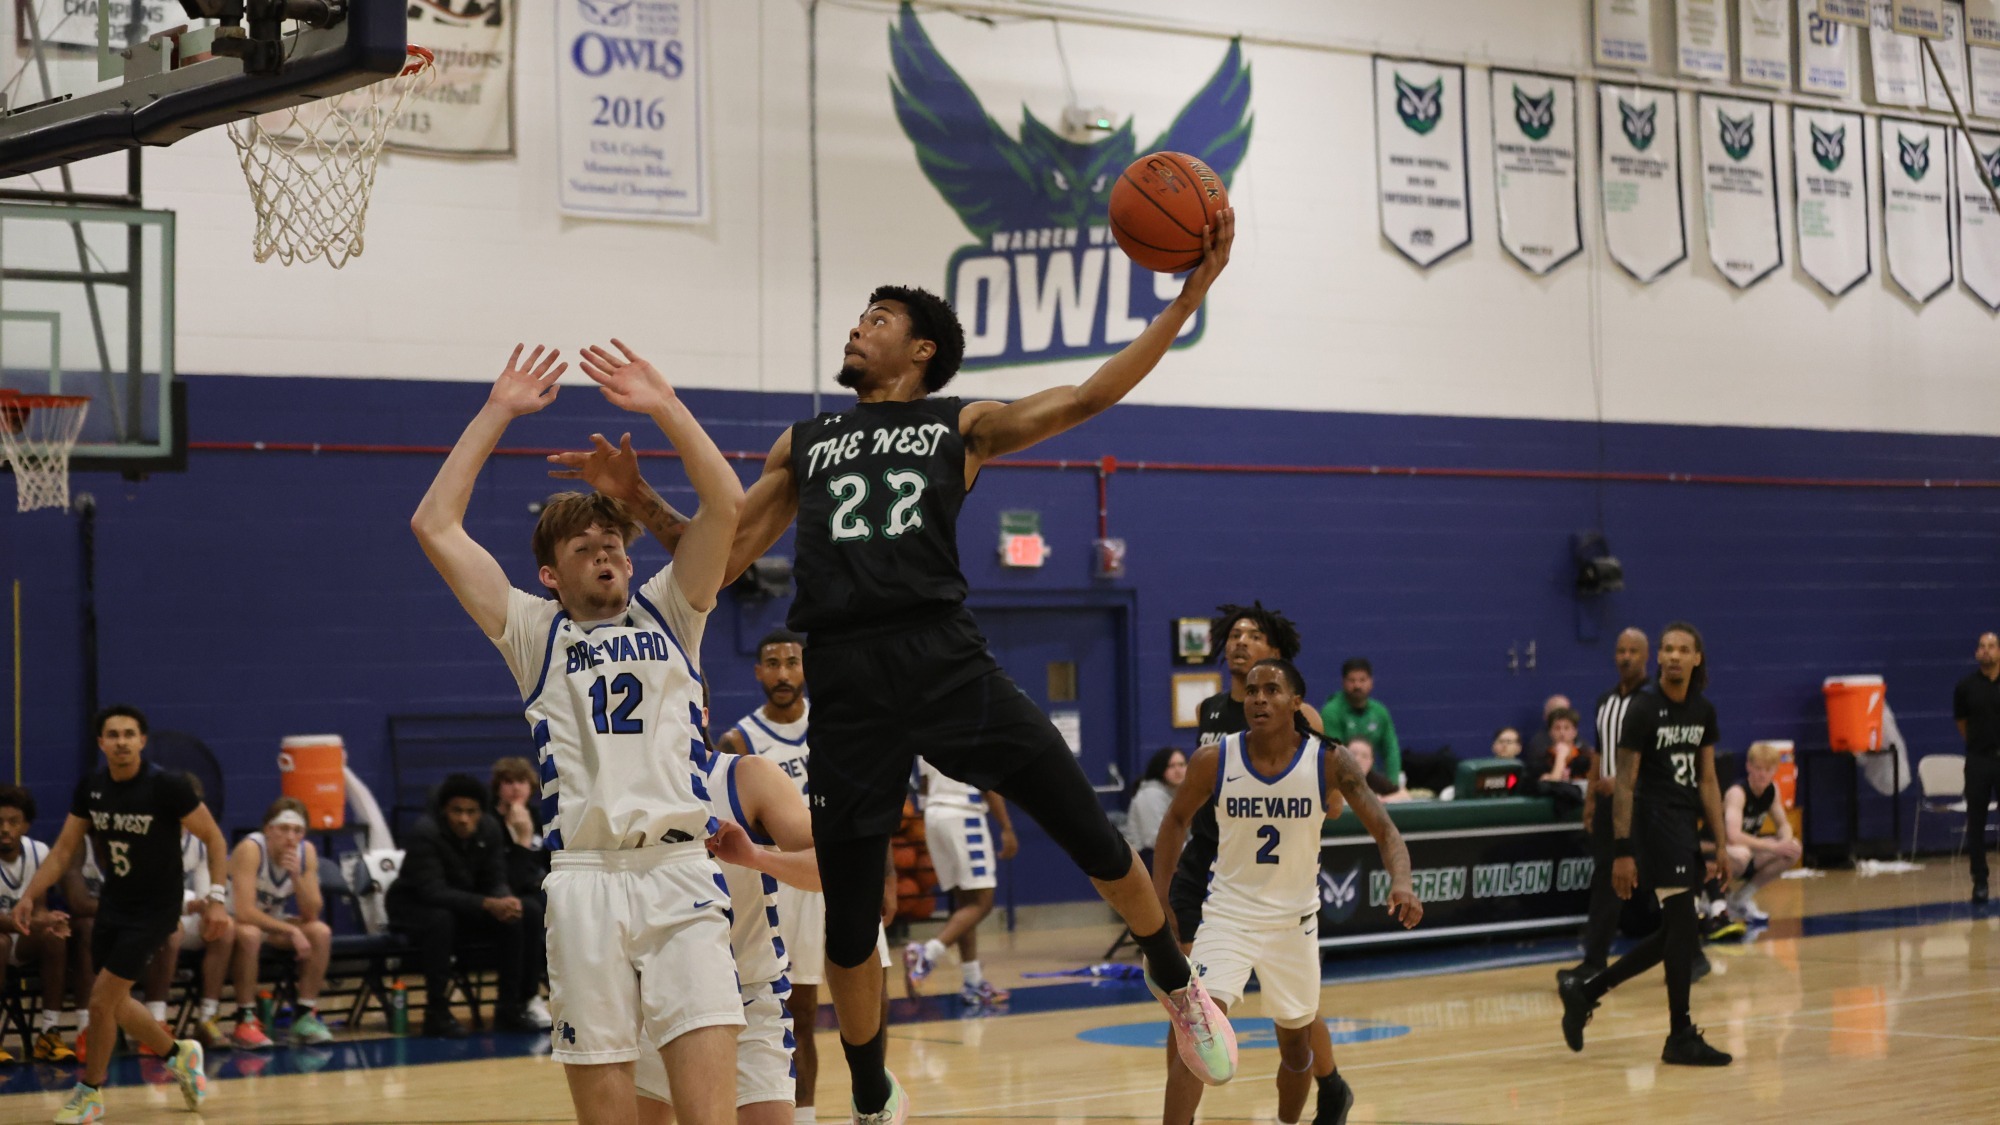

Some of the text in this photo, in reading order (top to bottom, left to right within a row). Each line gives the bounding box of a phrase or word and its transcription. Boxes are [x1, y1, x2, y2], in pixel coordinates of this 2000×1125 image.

[64, 0, 165, 23] CHAPINS
[572, 31, 683, 80] OWLS
[592, 95, 665, 131] 2016
[992, 227, 1078, 252] WARREN
[807, 423, 950, 480] THE NEST
[827, 468, 928, 544] 22
[566, 631, 669, 675] BREVARD
[588, 672, 643, 734] 12
[1670, 752, 1698, 788] 21
[113, 813, 154, 836] NEST
[1226, 797, 1312, 818] BREVARD
[108, 840, 131, 878] 5
[1256, 824, 1281, 864] 2
[1369, 866, 1468, 907] WRREN
[1472, 859, 1554, 899] WILSON
